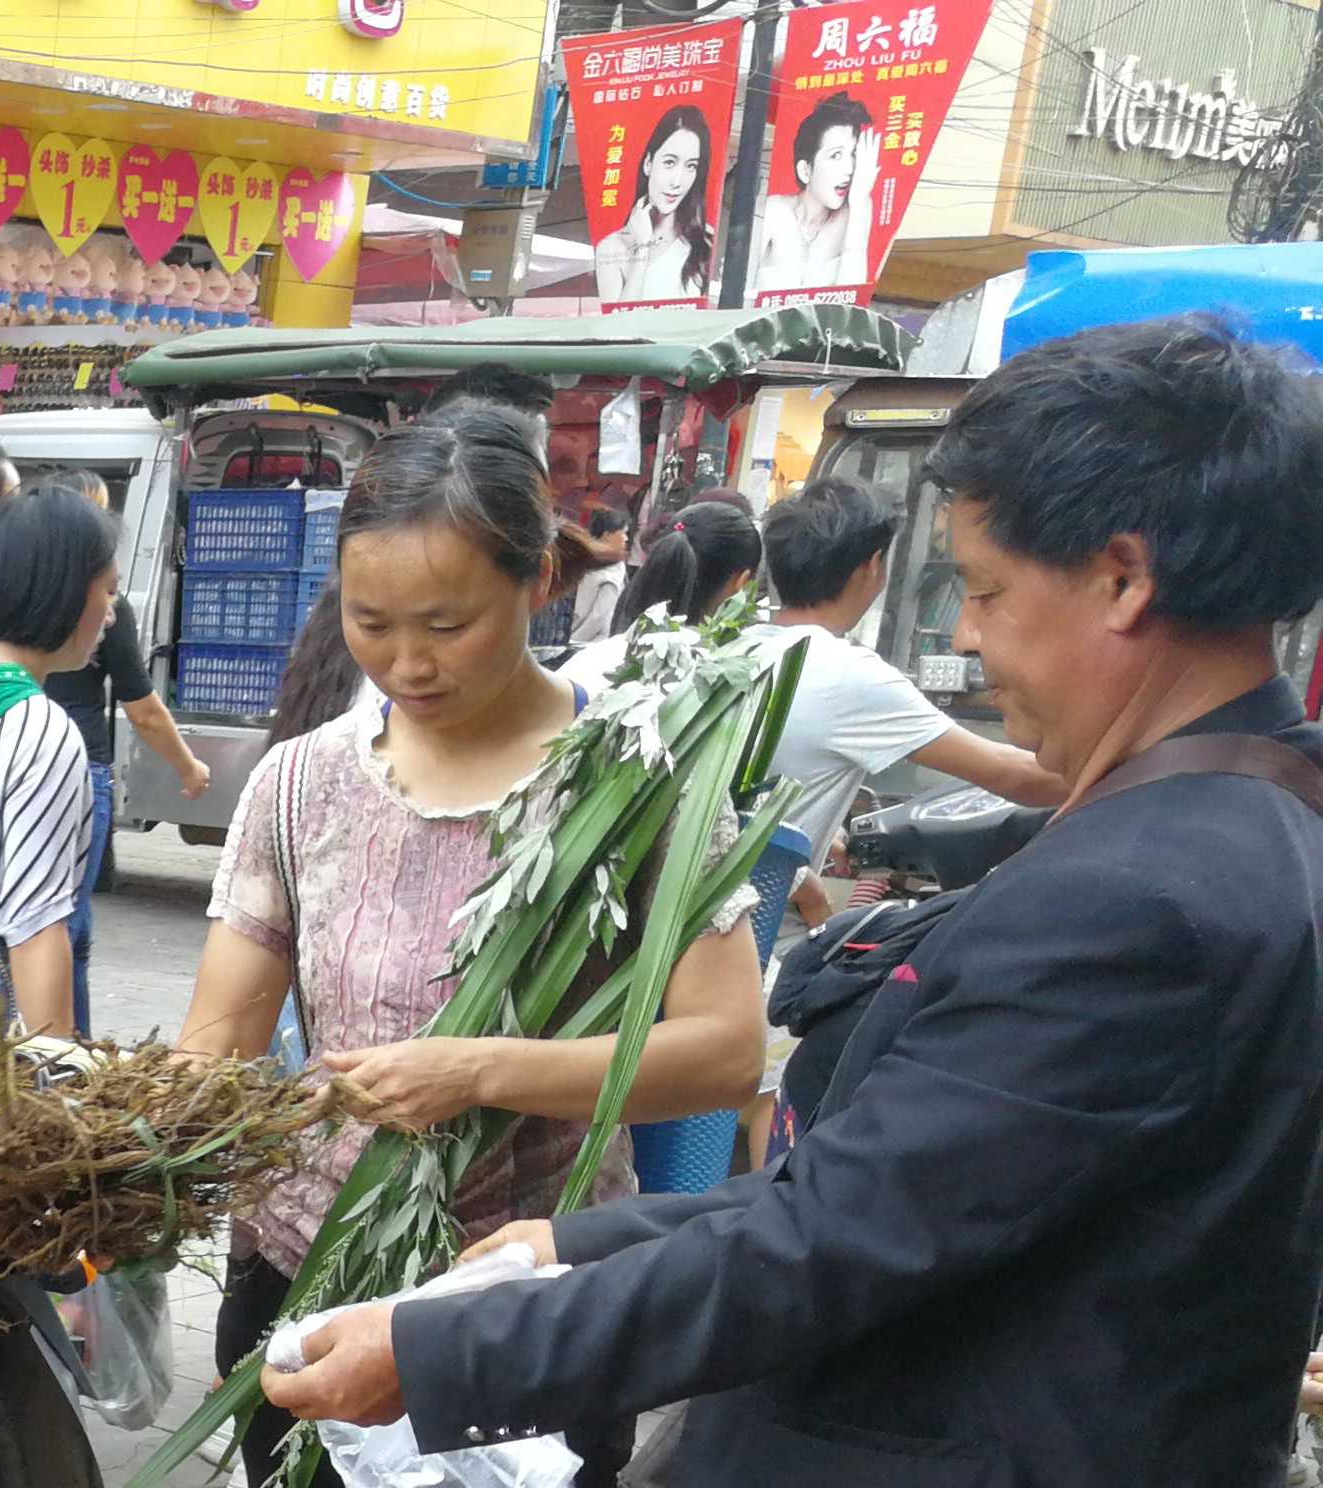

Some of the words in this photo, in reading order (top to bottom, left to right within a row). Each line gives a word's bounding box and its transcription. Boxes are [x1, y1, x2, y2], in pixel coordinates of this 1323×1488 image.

[812, 5, 938, 59] 周六福
[823, 57, 865, 71] ZHOU
[871, 53, 895, 66] LIU
[901, 50, 922, 62] FU
[883, 95, 906, 150] 买三金
[900, 112, 924, 166] 买放心
[80, 154, 111, 179] 秒杀
[122, 175, 195, 224] 买一送一
[283, 196, 349, 242] 买一送一
